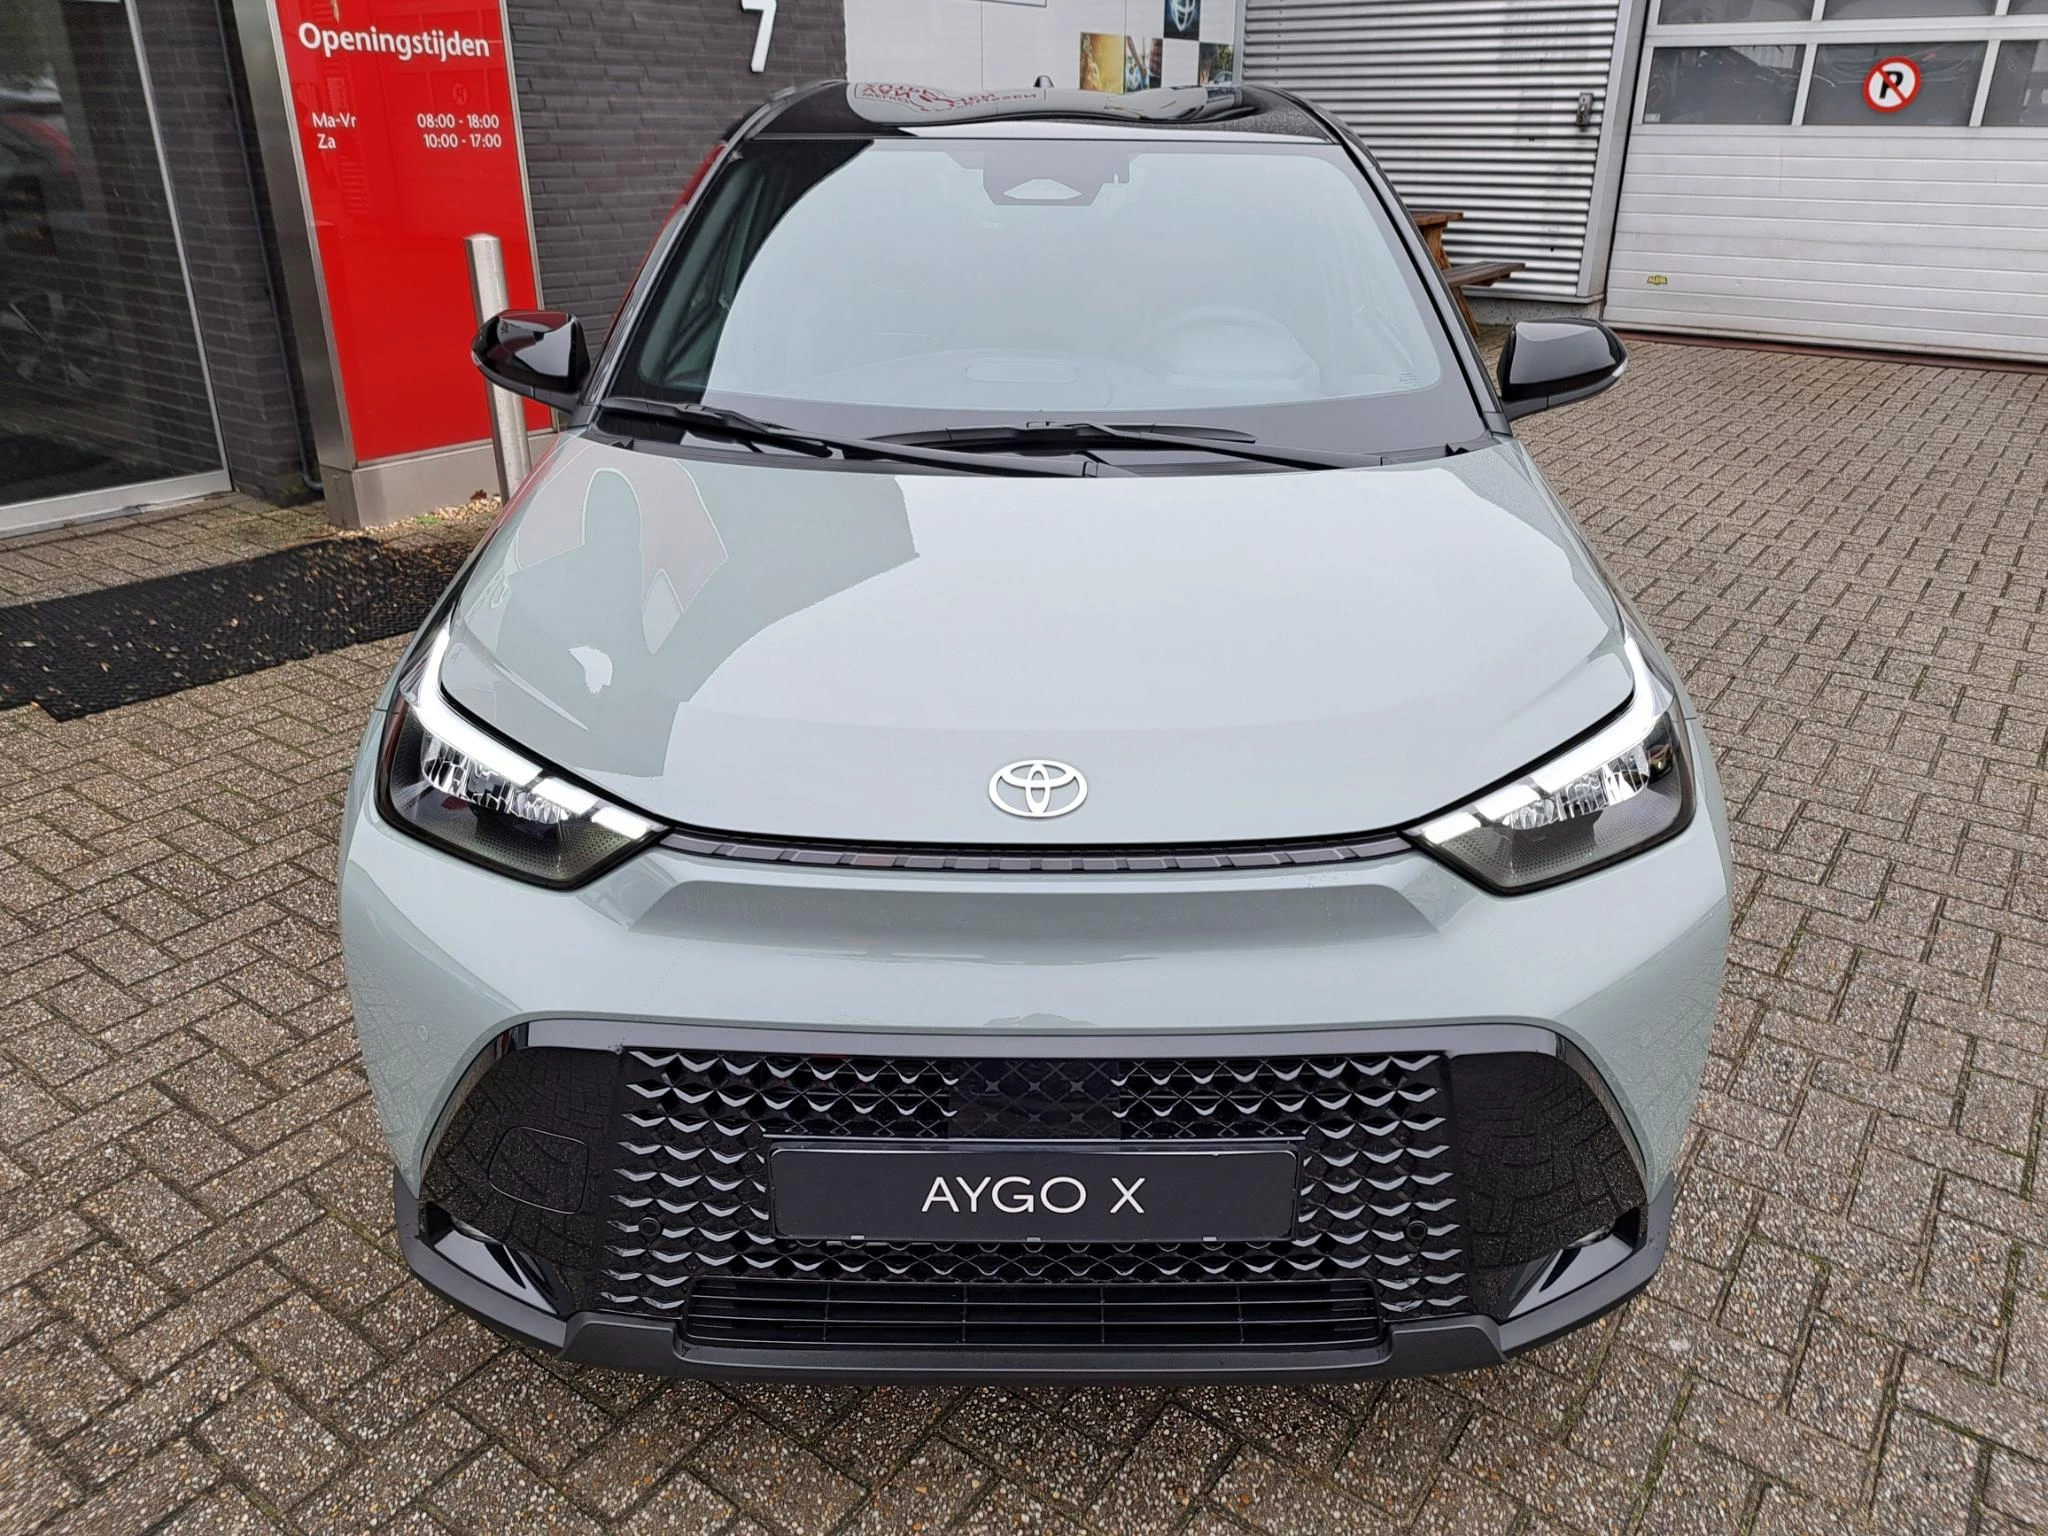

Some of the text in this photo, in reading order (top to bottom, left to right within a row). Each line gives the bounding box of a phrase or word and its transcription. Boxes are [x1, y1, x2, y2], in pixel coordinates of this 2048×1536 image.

[299, 22, 490, 62] Openingstijden
[741, 0, 777, 72] 7
[1879, 70, 1904, 99] P
[312, 112, 356, 128] Ma-Vr
[417, 113, 455, 129] 08:00
[467, 113, 499, 129] 18:00
[316, 133, 337, 149] Za
[423, 133, 458, 148] 10:00
[470, 133, 502, 148] 17:00
[921, 1175, 1146, 1214] AYGO X
